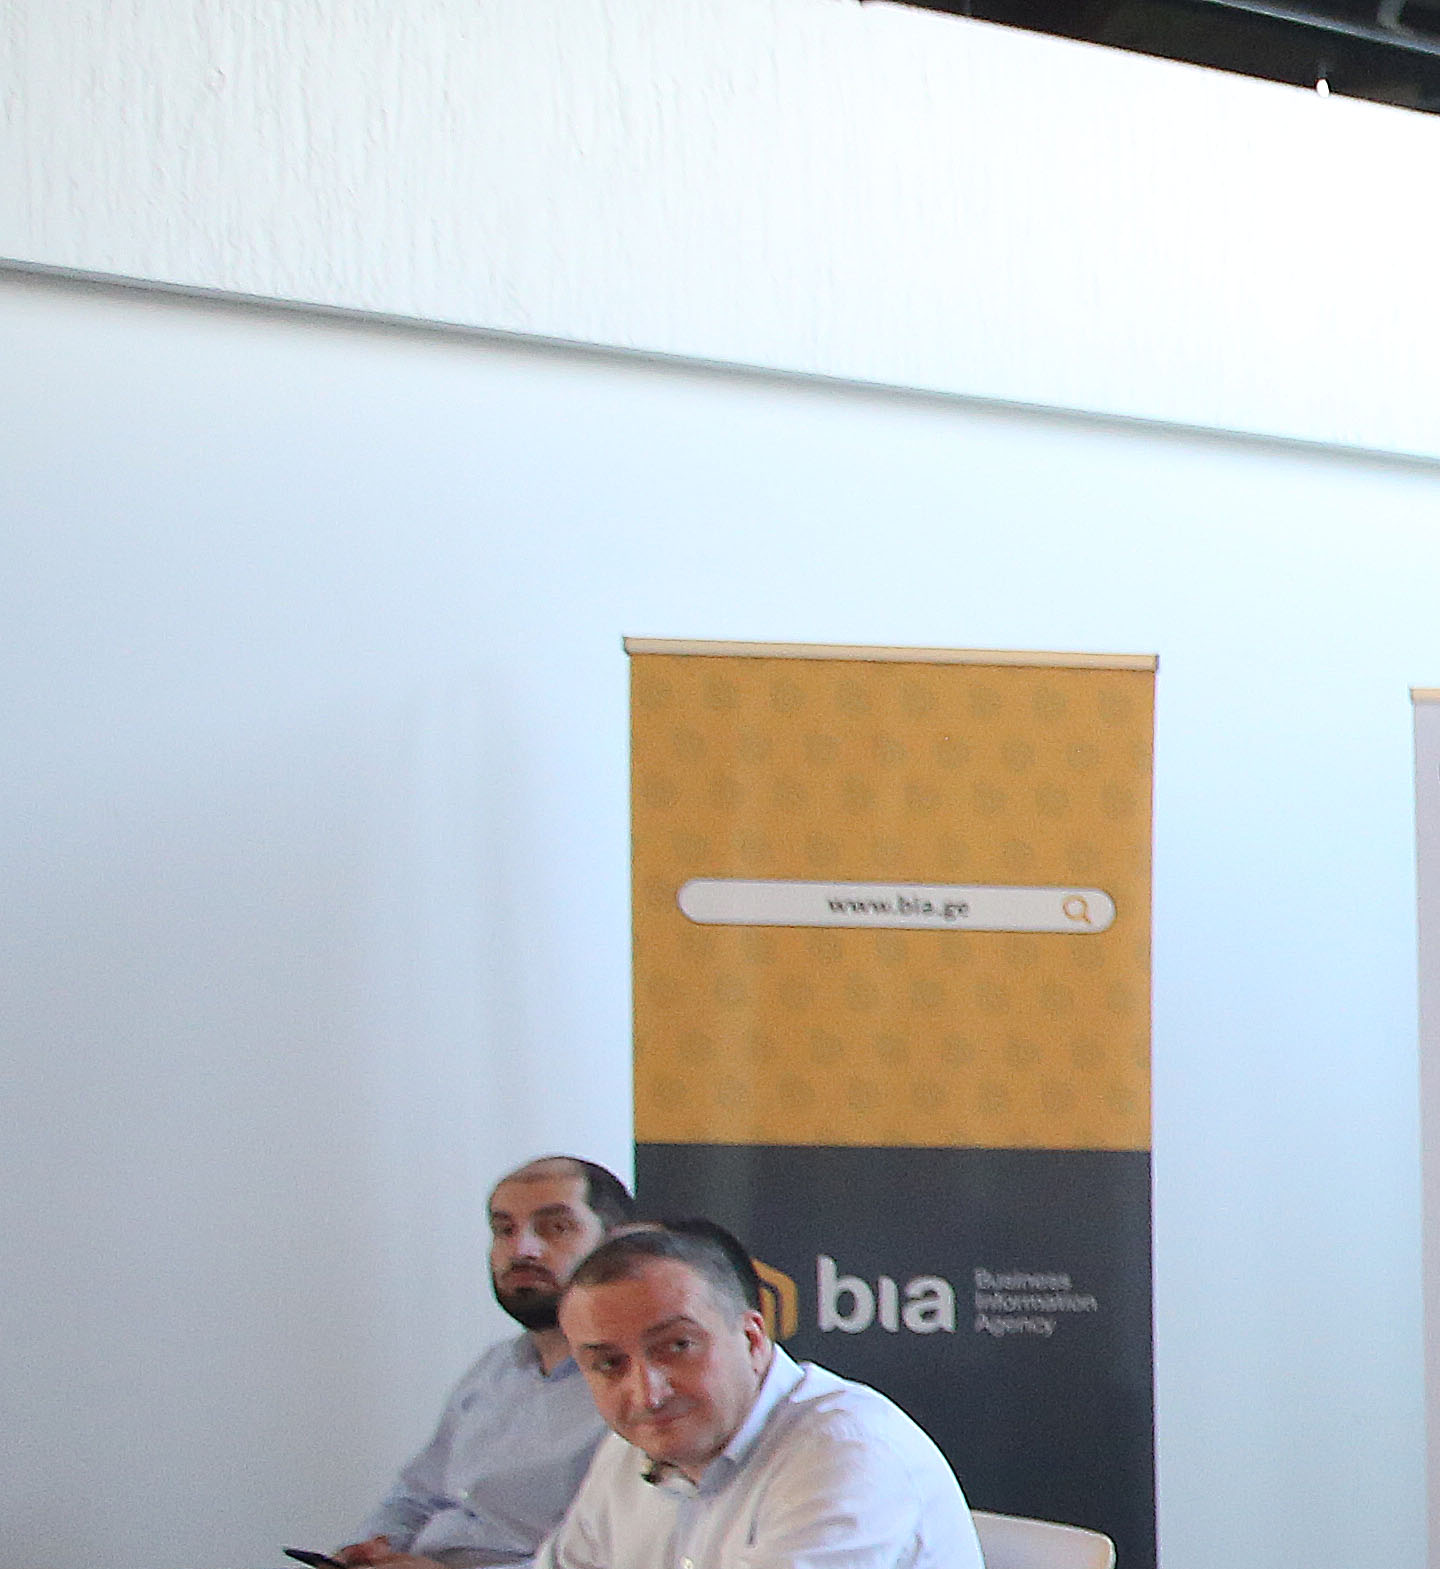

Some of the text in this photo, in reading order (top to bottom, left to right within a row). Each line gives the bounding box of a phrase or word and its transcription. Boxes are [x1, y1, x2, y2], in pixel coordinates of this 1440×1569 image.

[826, 894, 969, 921] www.bia.ge
[975, 1267, 1073, 1290] Business
[816, 1254, 957, 1335] bia
[975, 1290, 1099, 1313] Information
[975, 1313, 1058, 1338] Agency
